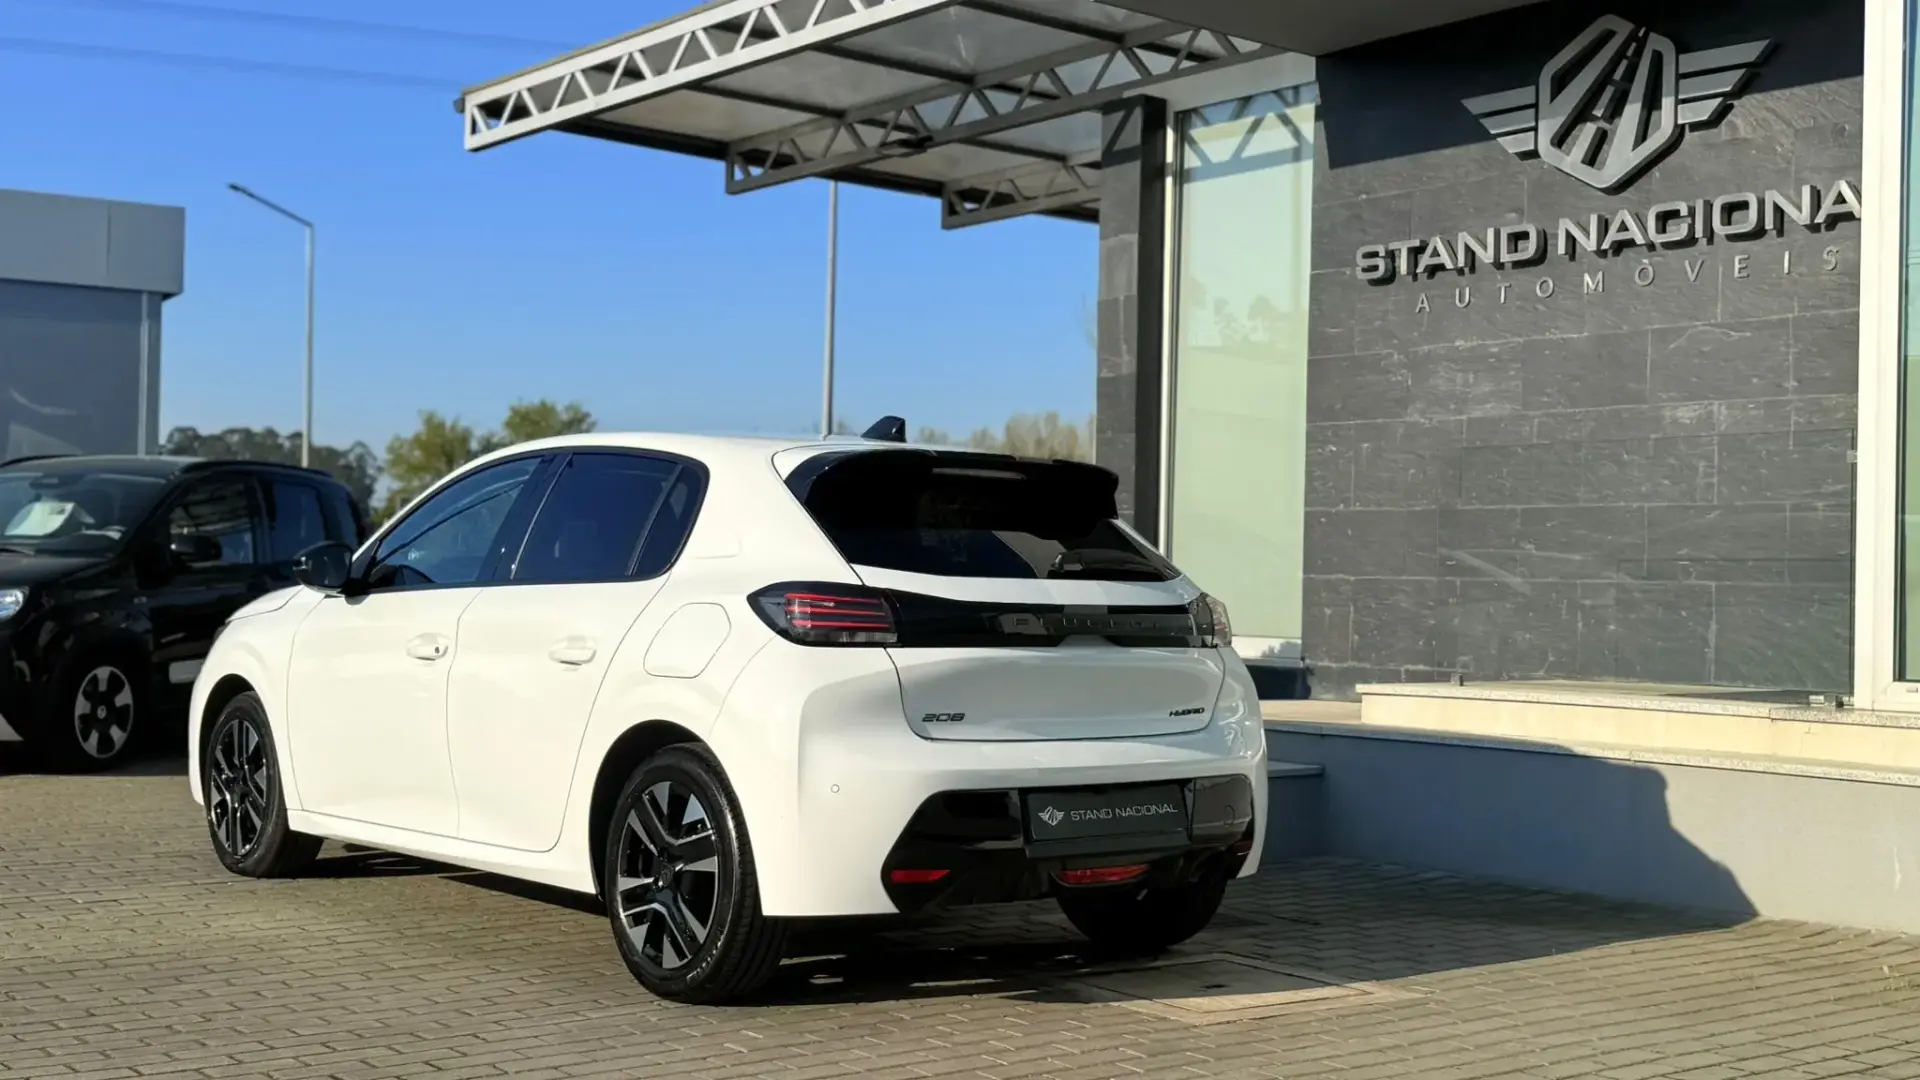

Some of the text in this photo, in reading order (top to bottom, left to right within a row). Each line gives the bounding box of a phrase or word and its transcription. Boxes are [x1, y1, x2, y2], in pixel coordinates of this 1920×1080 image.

[1356, 179, 1861, 280] STAND NACIONA
[922, 712, 966, 722] 208
[1070, 803, 1178, 821] STAND NACIONAL
